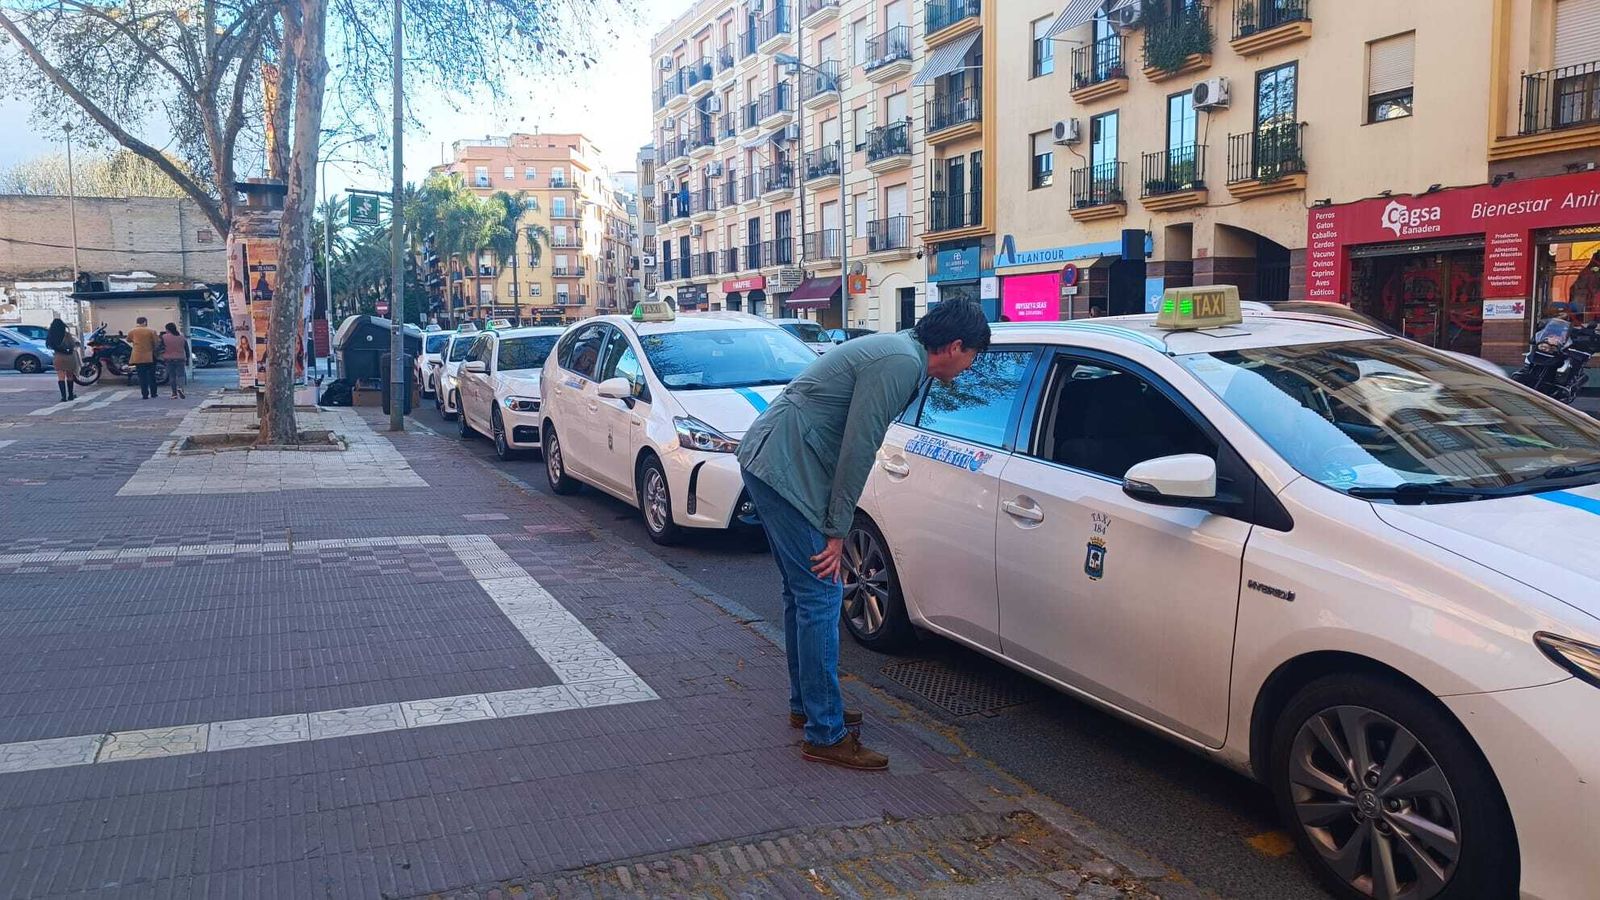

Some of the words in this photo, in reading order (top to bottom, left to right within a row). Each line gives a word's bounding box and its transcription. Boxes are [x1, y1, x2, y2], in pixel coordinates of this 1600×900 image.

[1471, 198, 1553, 219] Bienestar
[1315, 212, 1335, 220] Perros
[1387, 205, 1441, 227] Cagsa
[1316, 222, 1334, 230] Gatos
[1402, 224, 1441, 235] ganadera
[1312, 230, 1337, 239] Caballos
[998, 234, 1064, 266] ATLANTOUR
[1313, 241, 1335, 249] Cerdos
[1312, 260, 1334, 268] Ovinos
[1311, 269, 1335, 278] Caprino
[1310, 288, 1335, 296] Exóticos
[643, 303, 661, 314] TAXI
[1193, 293, 1225, 318] TAXI
[1091, 512, 1111, 527] TAXI
[1094, 523, 1106, 535] 184
